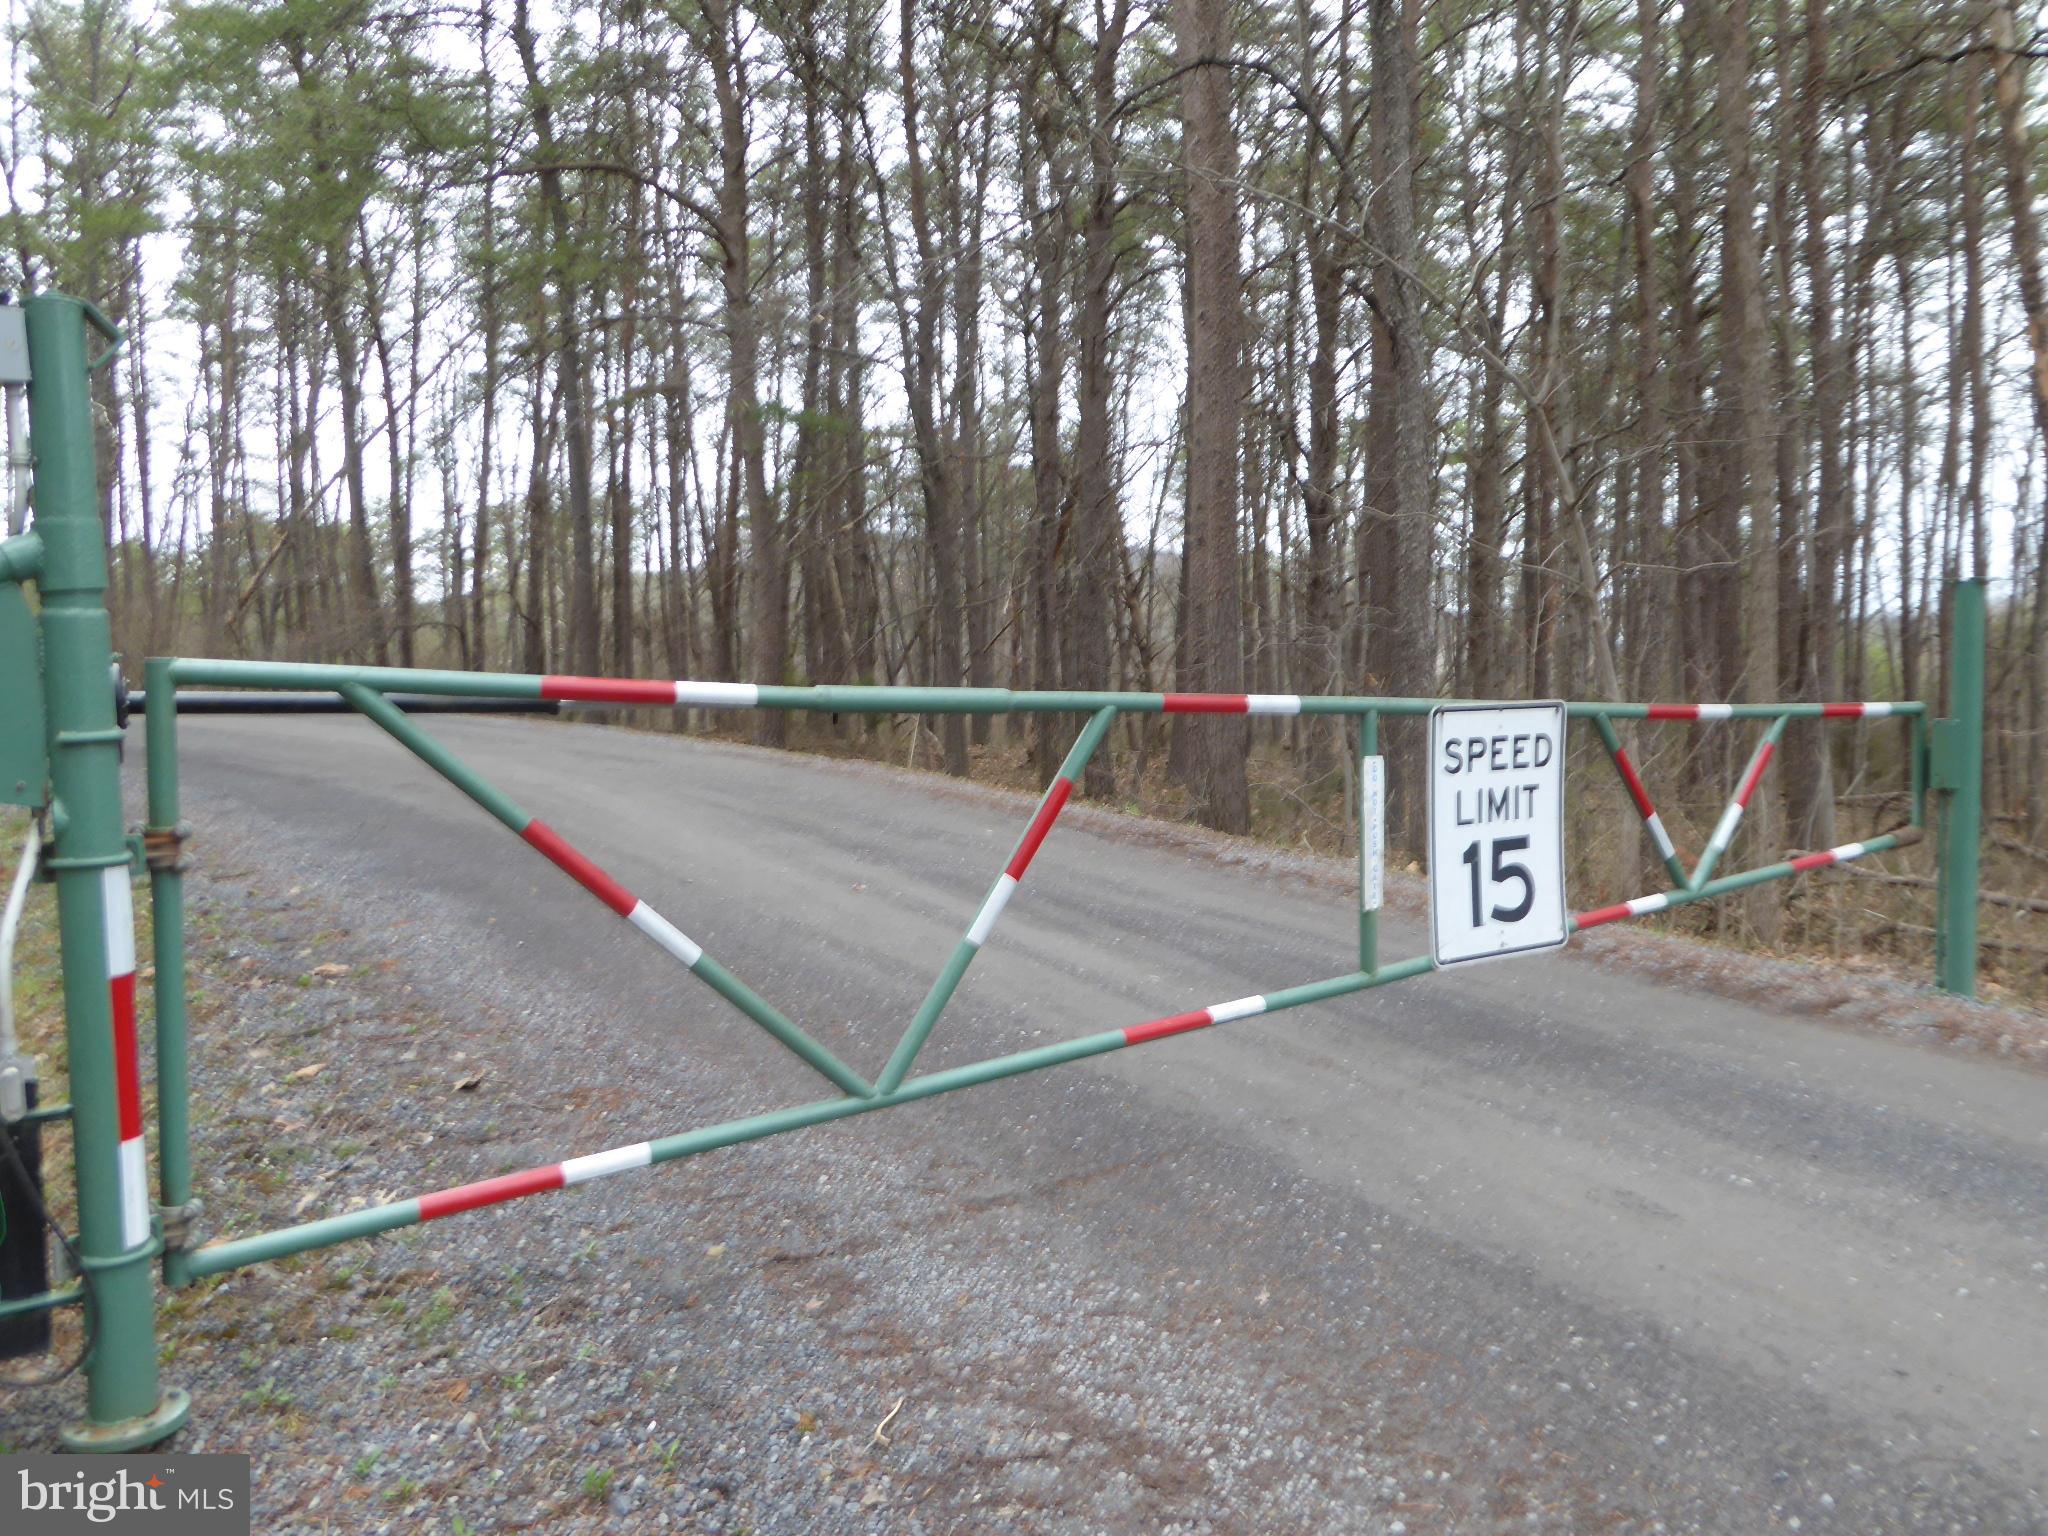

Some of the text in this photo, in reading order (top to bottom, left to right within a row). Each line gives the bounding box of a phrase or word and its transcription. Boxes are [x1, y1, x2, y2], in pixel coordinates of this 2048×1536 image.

[1444, 732, 1553, 775] SPEED
[1456, 783, 1540, 826] LIMIT
[1463, 834, 1536, 928] 15
